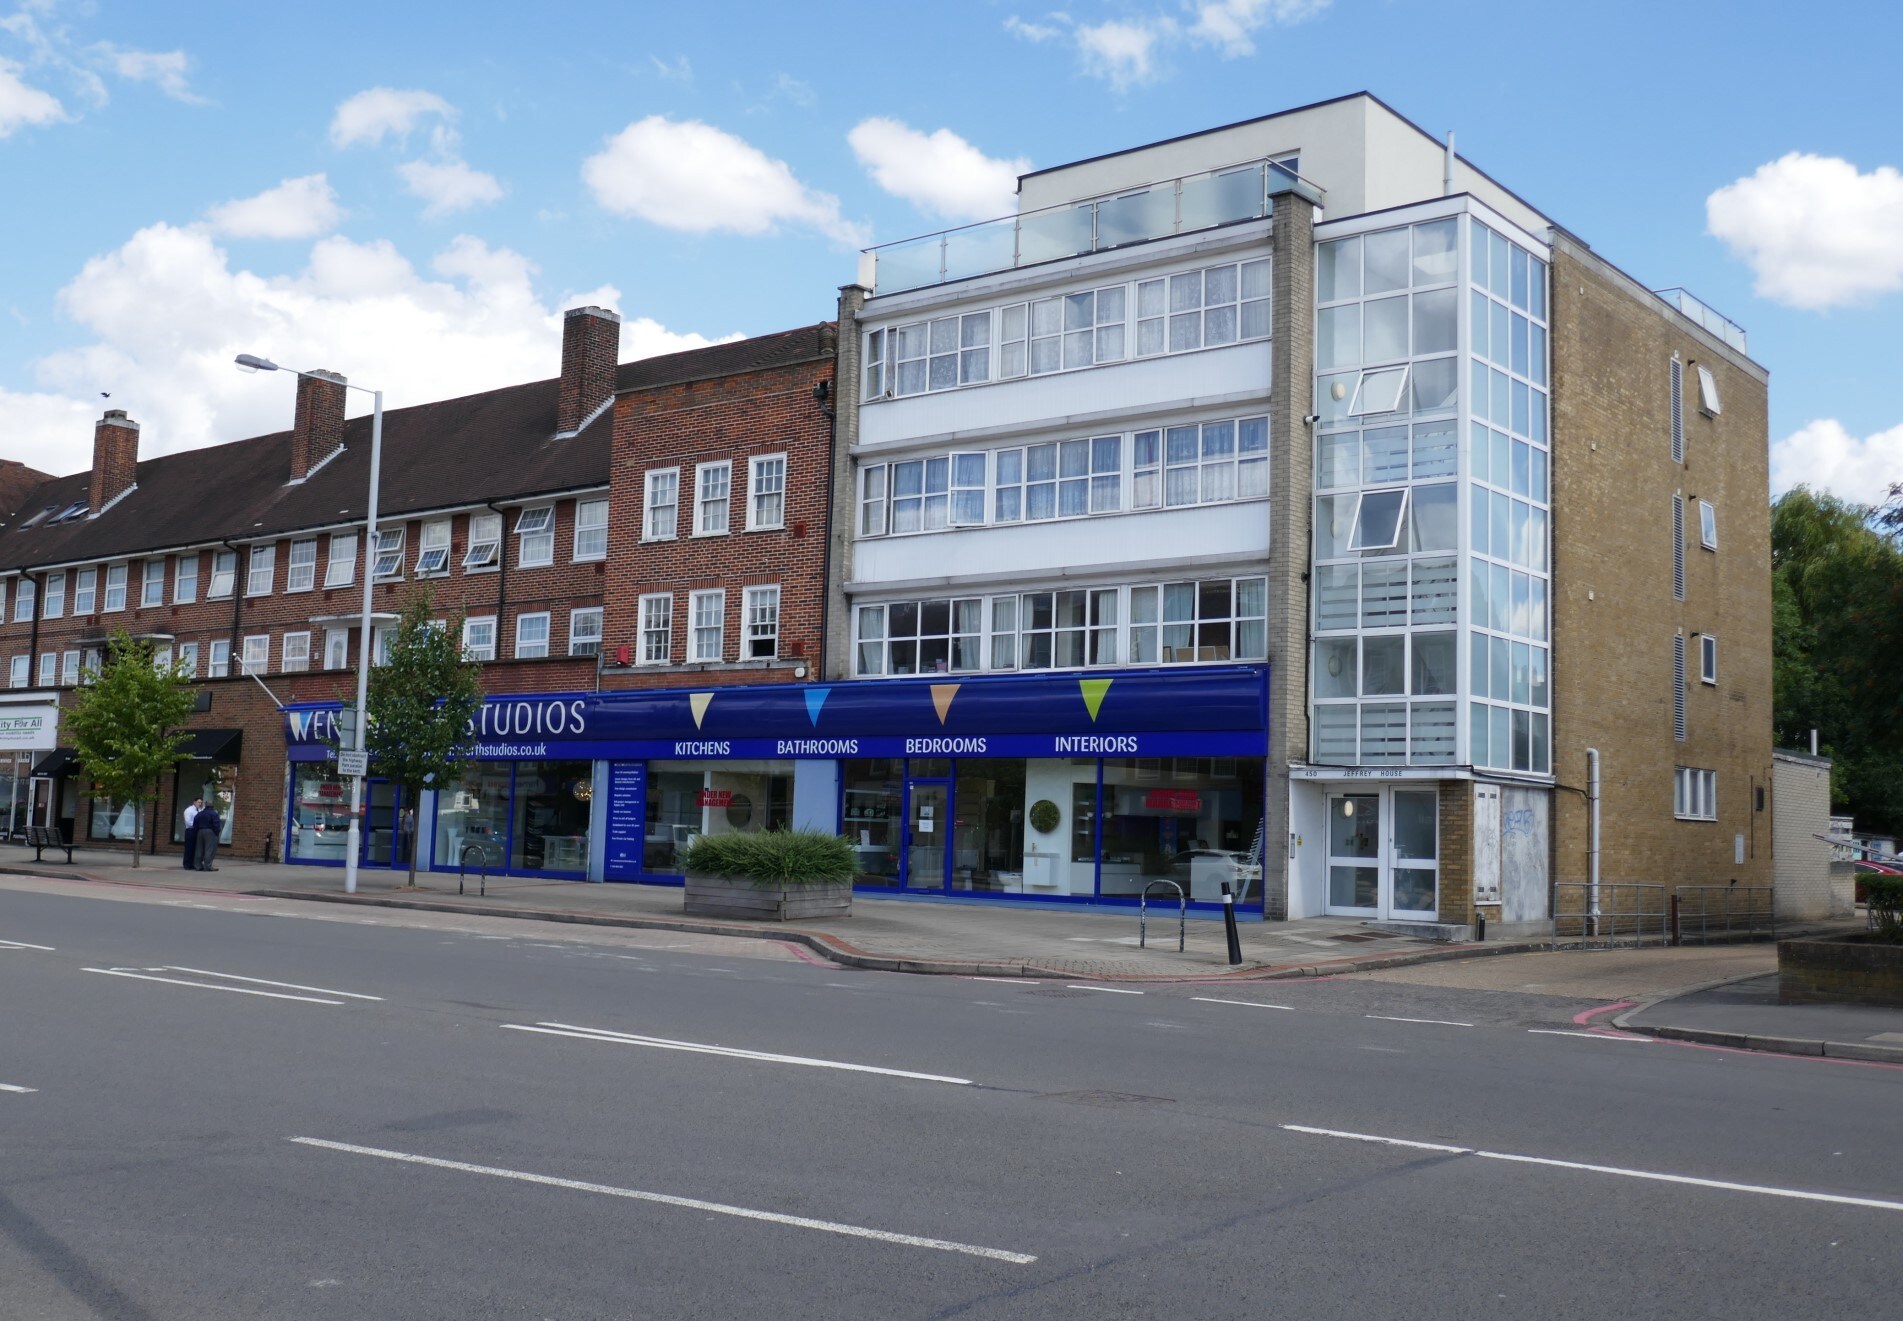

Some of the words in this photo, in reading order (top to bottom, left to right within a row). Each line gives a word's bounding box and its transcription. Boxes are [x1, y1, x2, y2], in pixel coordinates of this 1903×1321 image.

[14, 720, 28, 728] For
[31, 719, 42, 727] All
[674, 741, 731, 755] KITCHENS
[776, 739, 859, 754] BATHROOMS
[905, 738, 986, 753] BEDROOMS
[1055, 736, 1138, 752] INTERIORS
